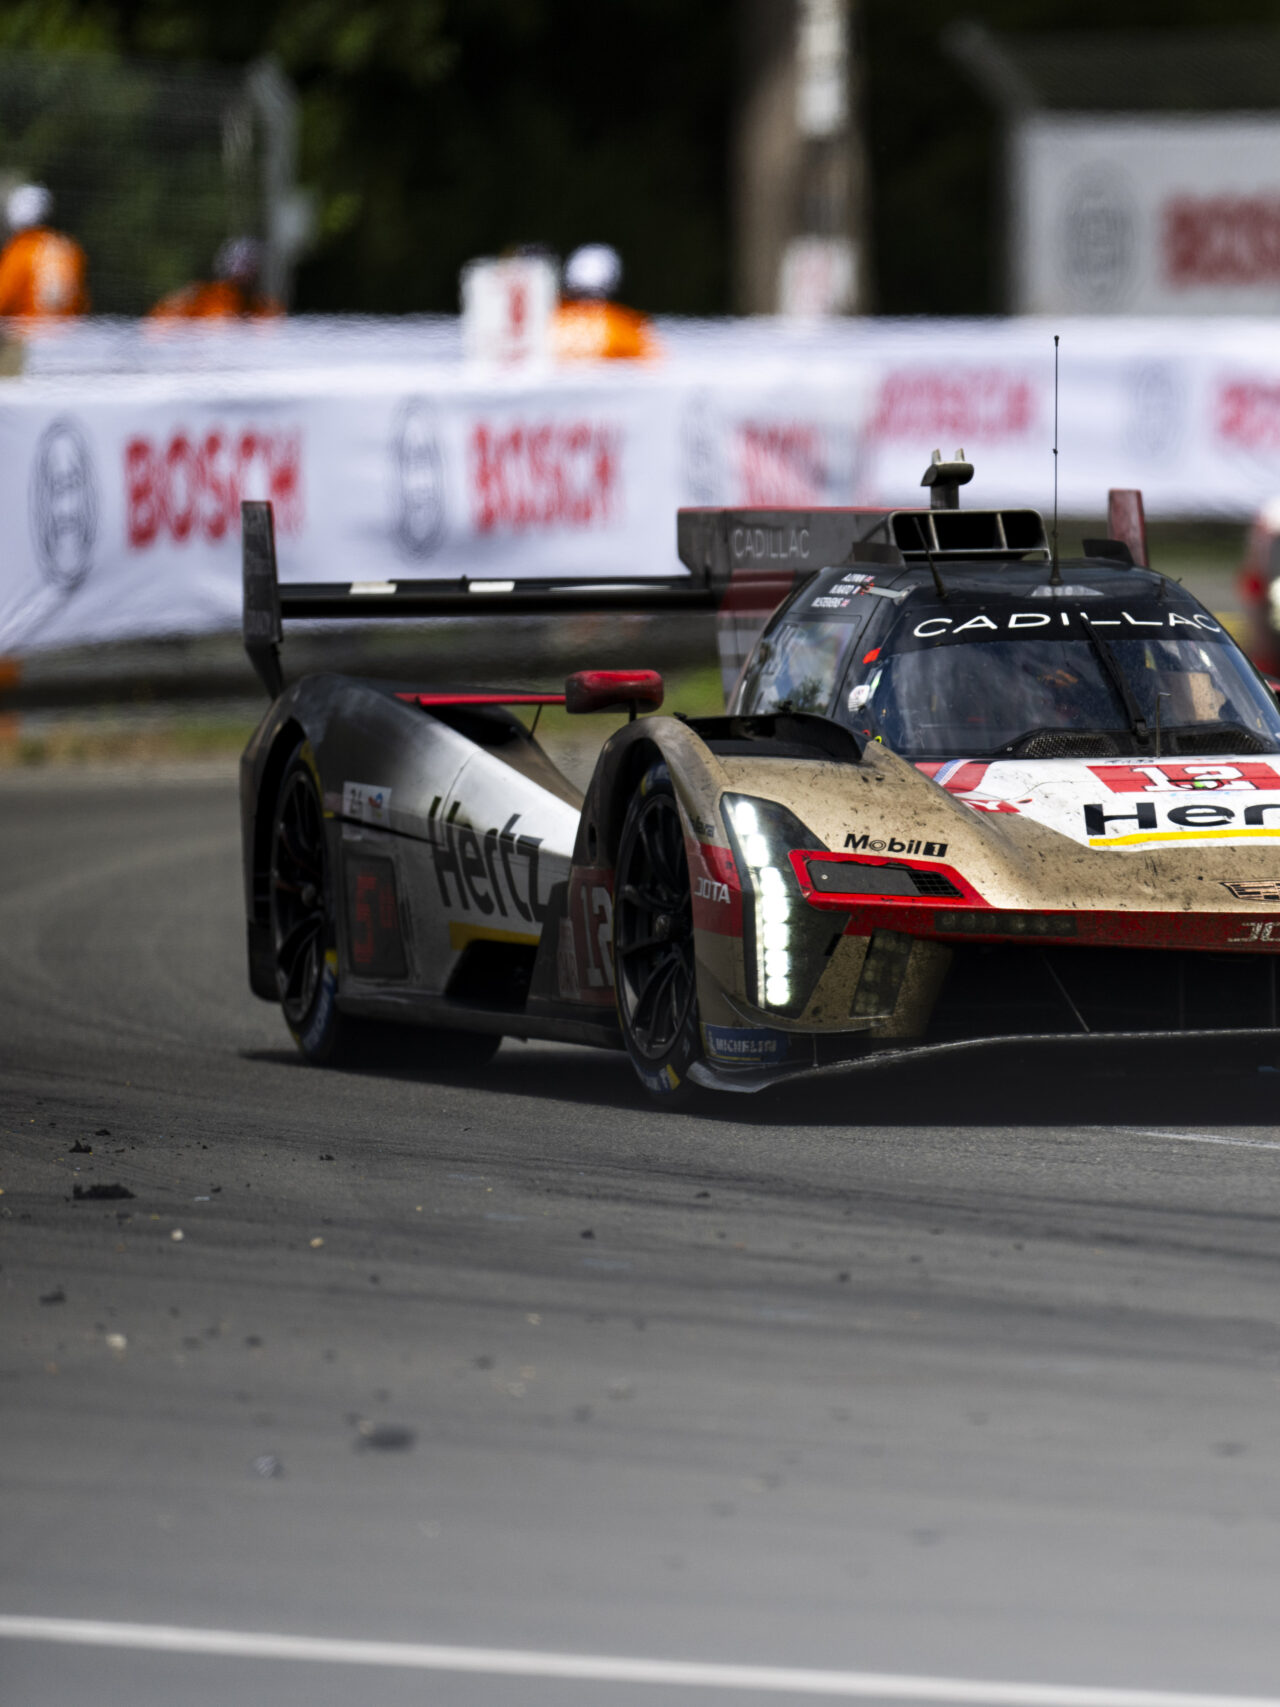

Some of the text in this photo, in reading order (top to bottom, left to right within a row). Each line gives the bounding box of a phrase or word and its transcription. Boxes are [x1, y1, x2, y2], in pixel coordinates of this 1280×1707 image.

[733, 528, 810, 559] CADILLAC
[913, 611, 1221, 638] CADILLAC
[1131, 765, 1260, 792] 12
[428, 795, 549, 924] Hertz
[694, 876, 731, 904] JOTA
[580, 884, 615, 987] 12
[714, 1037, 777, 1054] MICHELIN
